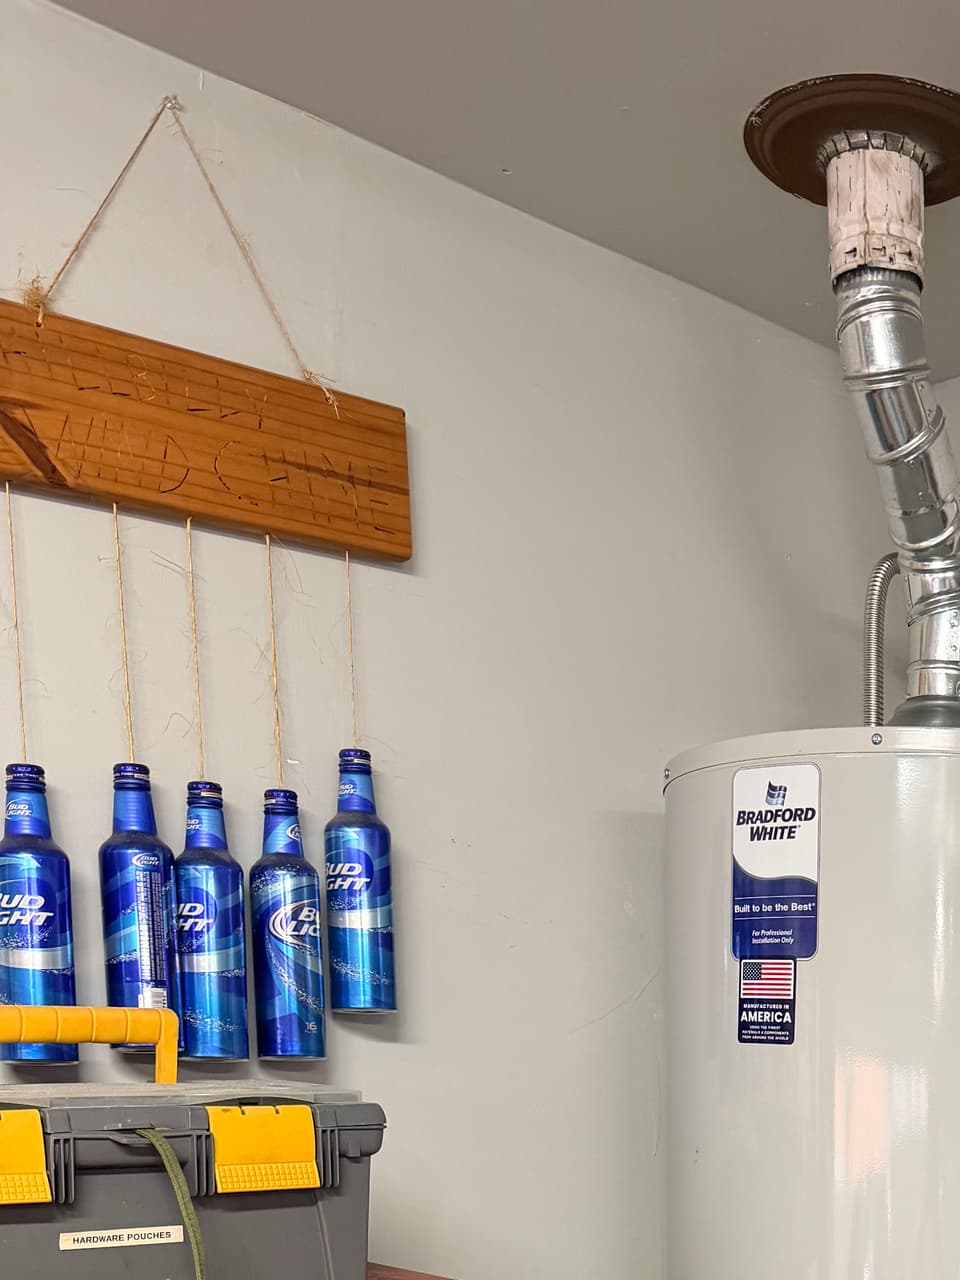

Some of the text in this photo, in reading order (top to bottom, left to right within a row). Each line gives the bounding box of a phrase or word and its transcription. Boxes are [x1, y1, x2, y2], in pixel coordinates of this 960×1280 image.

[736, 807, 816, 826] BRADFORD
[750, 825, 797, 841] WHITE
[734, 904, 751, 913] Built
[752, 904, 760, 912] to
[762, 903, 772, 912] be
[775, 903, 789, 911] the
[741, 1011, 792, 1023] AMERICA
[305, 1022, 317, 1030] 16
[72, 1231, 172, 1245] HARDWARE POUCHES
